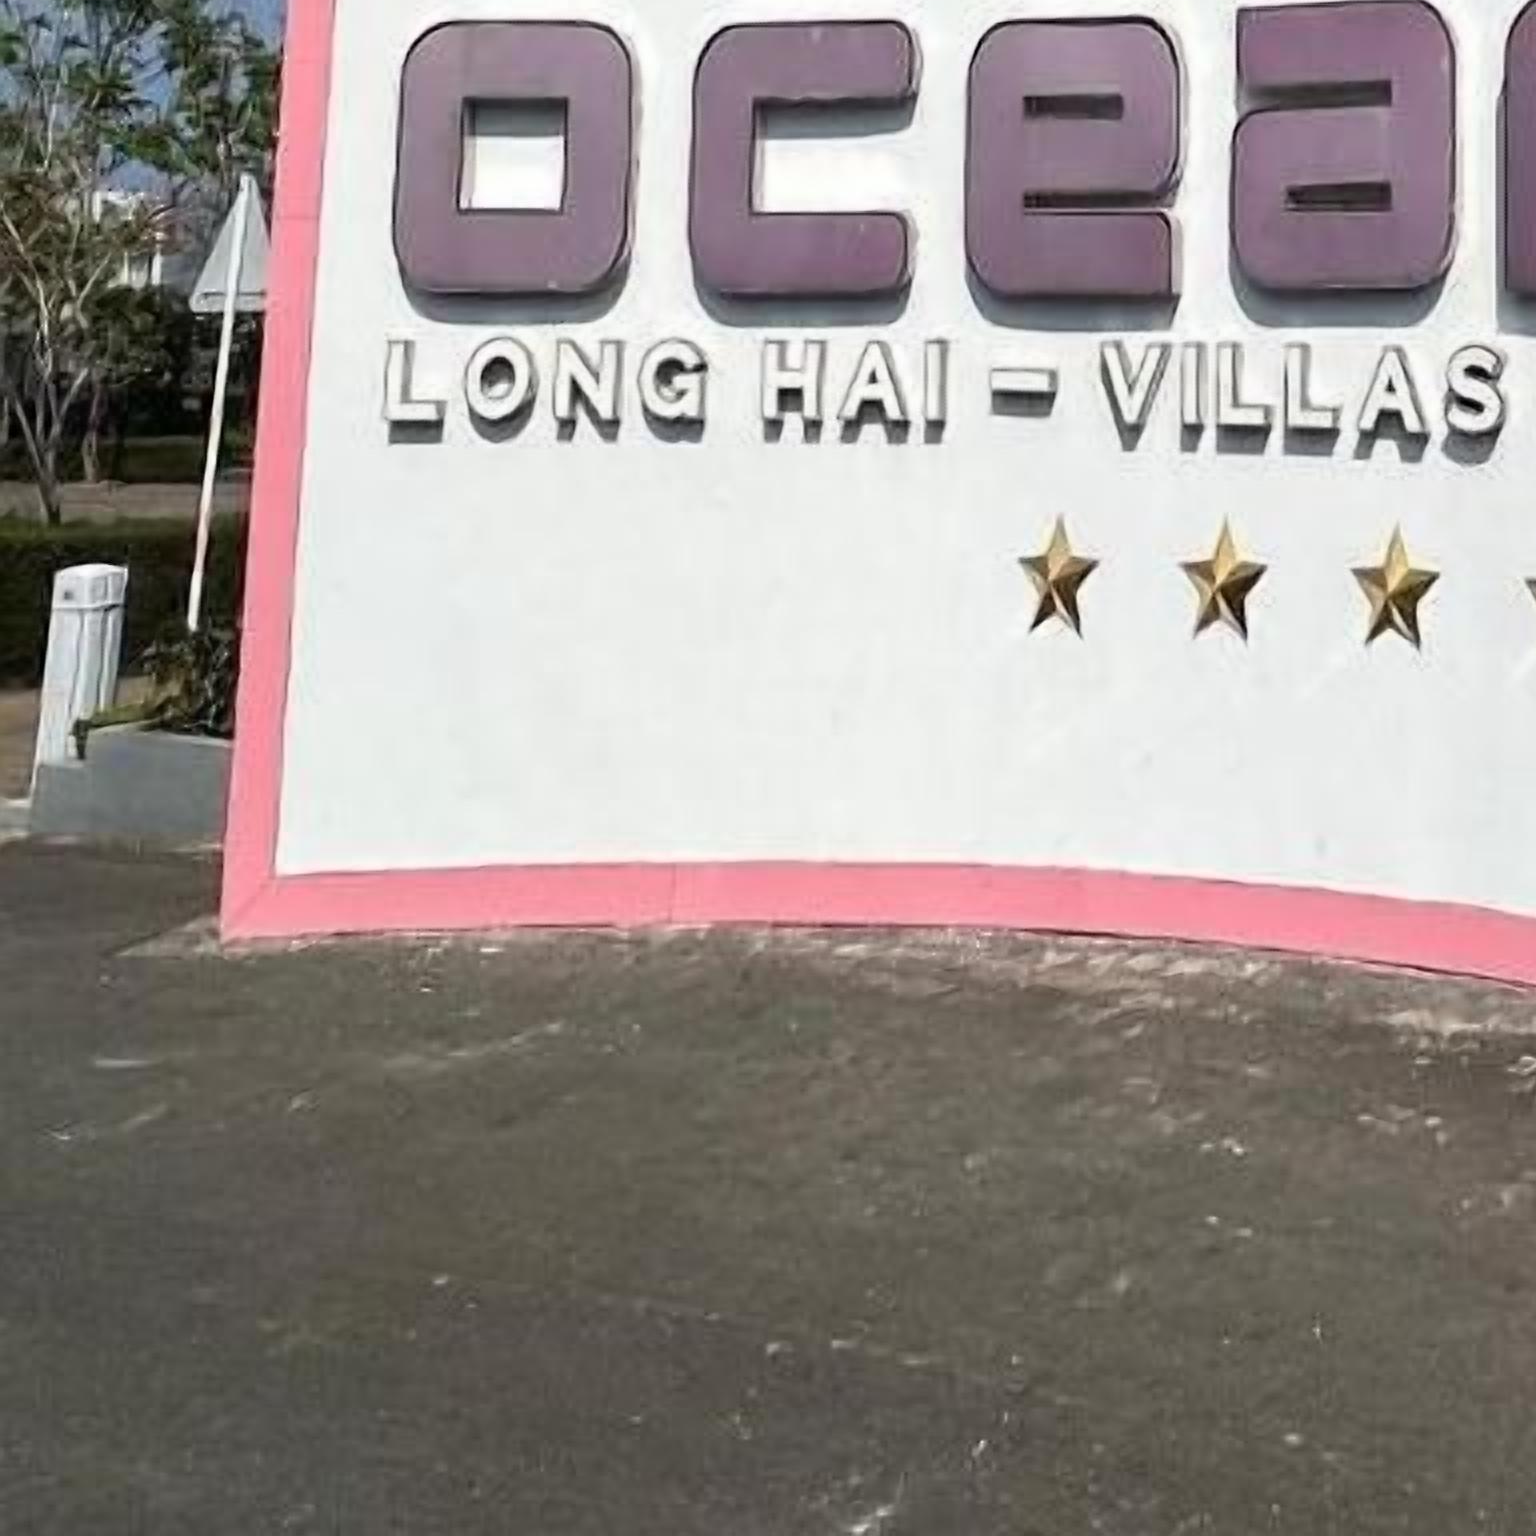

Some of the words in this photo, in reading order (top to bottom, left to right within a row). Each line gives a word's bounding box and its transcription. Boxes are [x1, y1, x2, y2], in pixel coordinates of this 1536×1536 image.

[383, 338, 709, 429] LONG
[760, 339, 949, 429] HAI
[1100, 340, 1505, 439] VILLAS
